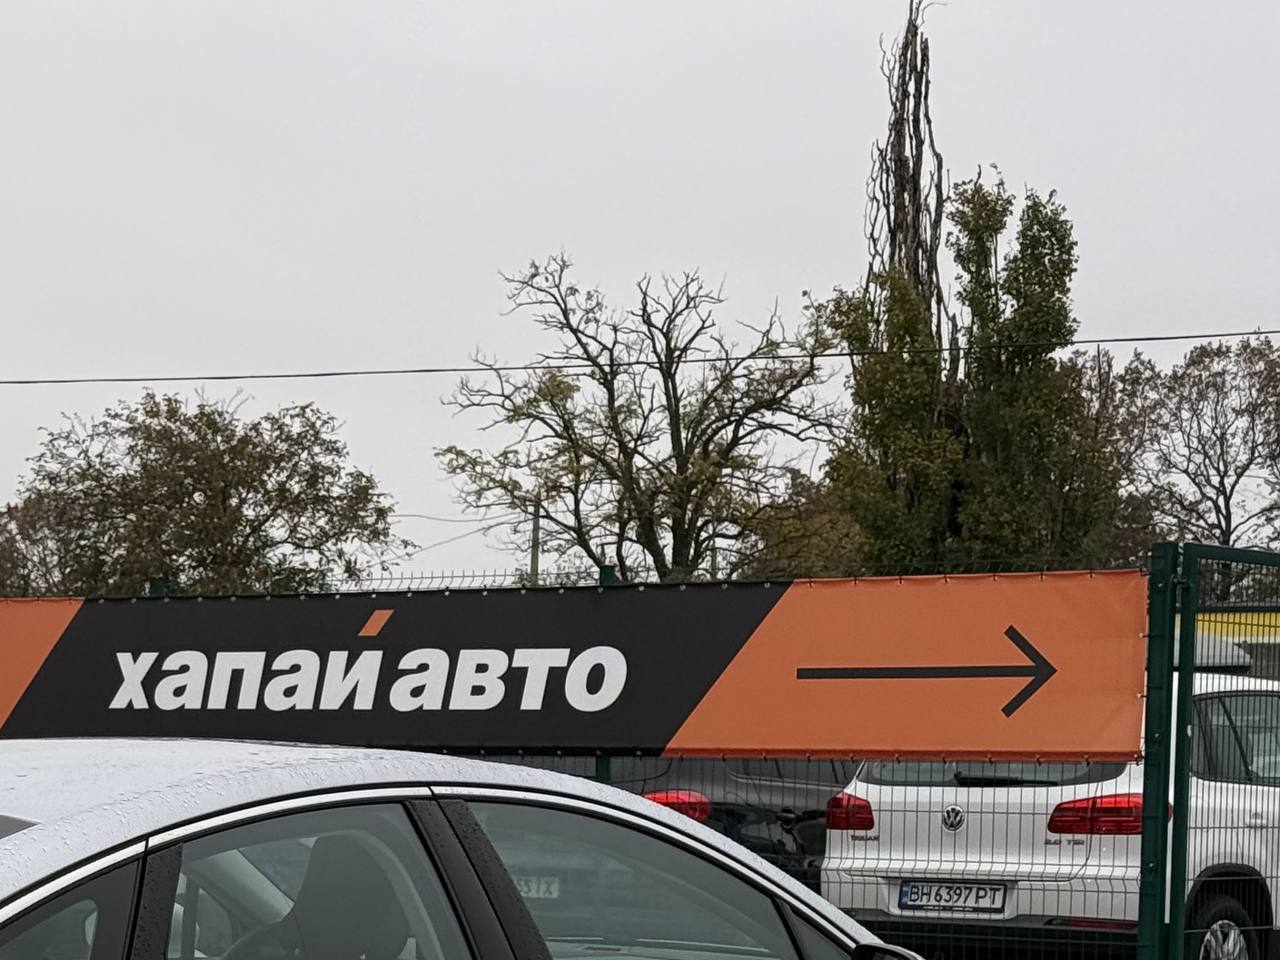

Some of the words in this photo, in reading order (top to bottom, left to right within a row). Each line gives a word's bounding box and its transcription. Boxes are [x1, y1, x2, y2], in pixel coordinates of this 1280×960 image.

[389, 645, 628, 712] авто
[909, 884, 932, 903] BH
[934, 886, 973, 904] 6397
[975, 887, 1001, 905] PT
